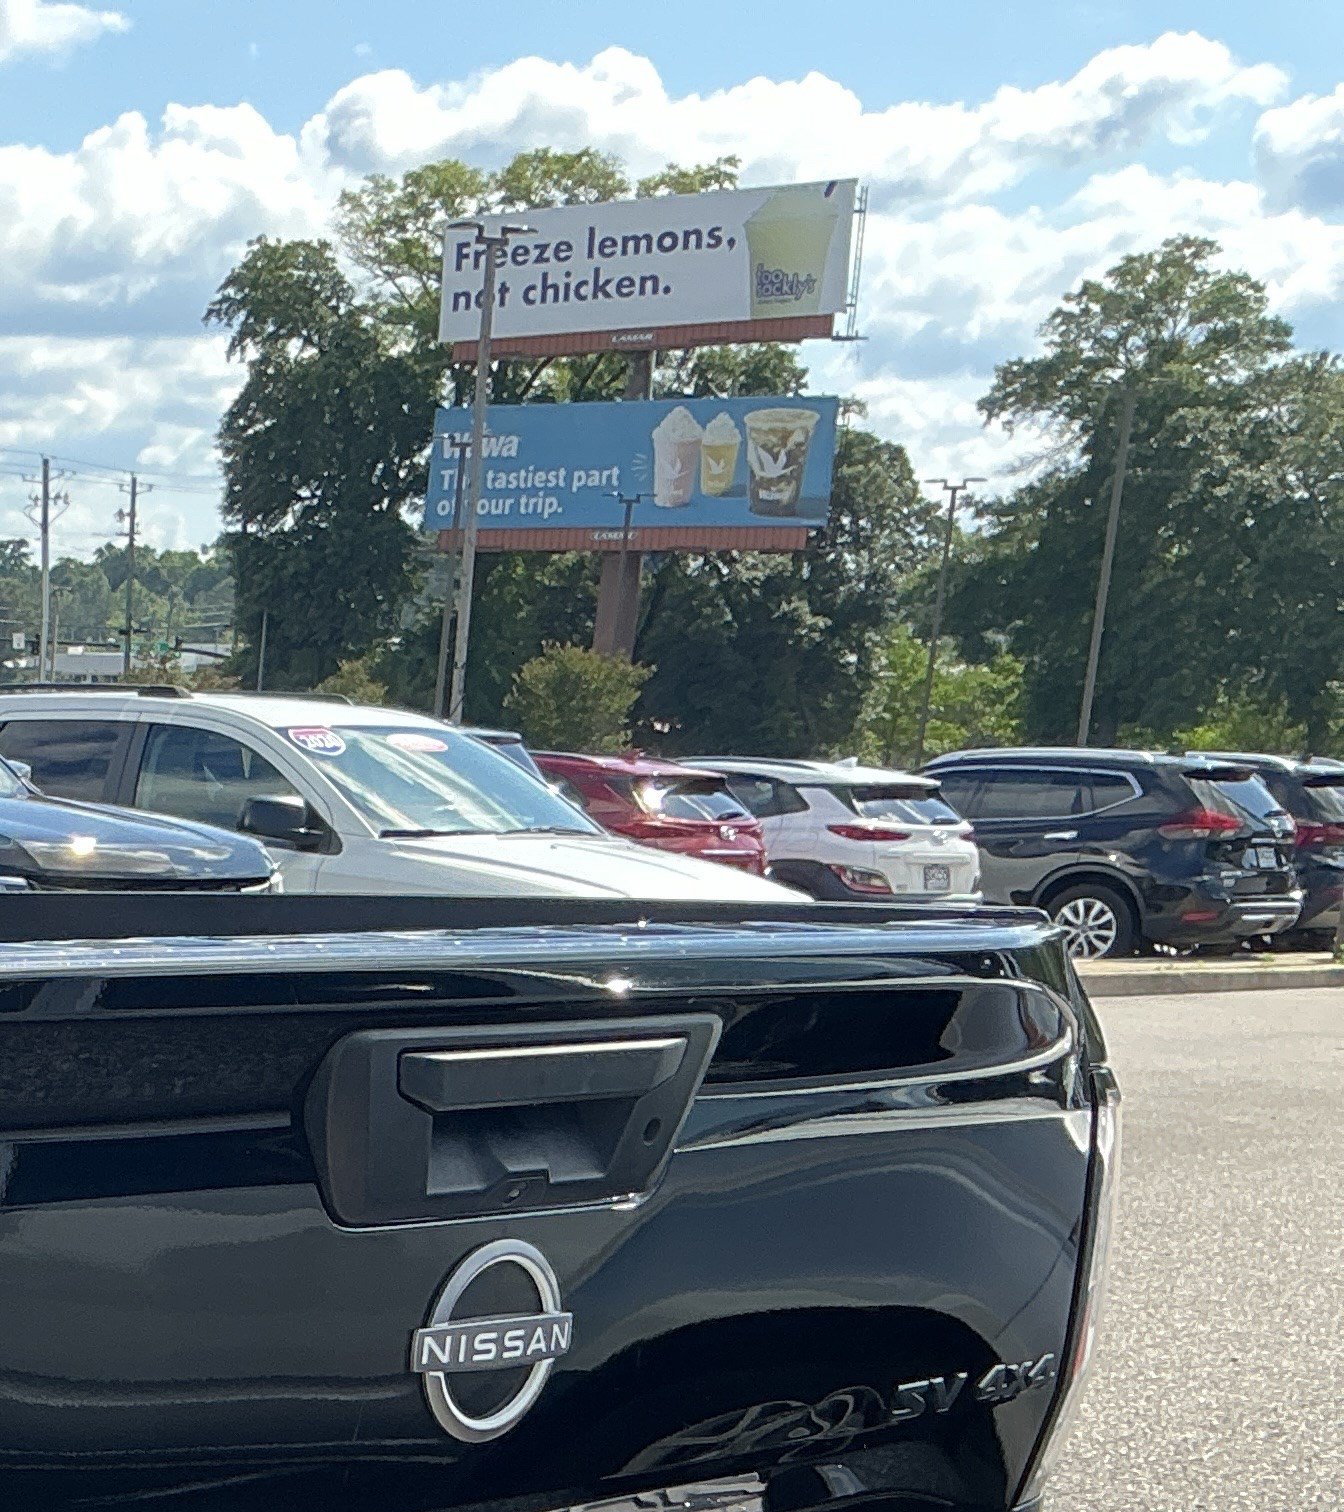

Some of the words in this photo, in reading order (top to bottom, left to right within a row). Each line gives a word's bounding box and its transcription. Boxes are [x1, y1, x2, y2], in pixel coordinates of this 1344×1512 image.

[455, 238, 574, 272] Freeze
[587, 225, 736, 260] lemons,
[521, 267, 672, 307] chicken.
[486, 466, 567, 490] tastiest
[572, 467, 620, 493] part
[519, 491, 563, 519] trip.
[421, 1321, 569, 1366] NISSAN
[891, 1371, 968, 1415] SV
